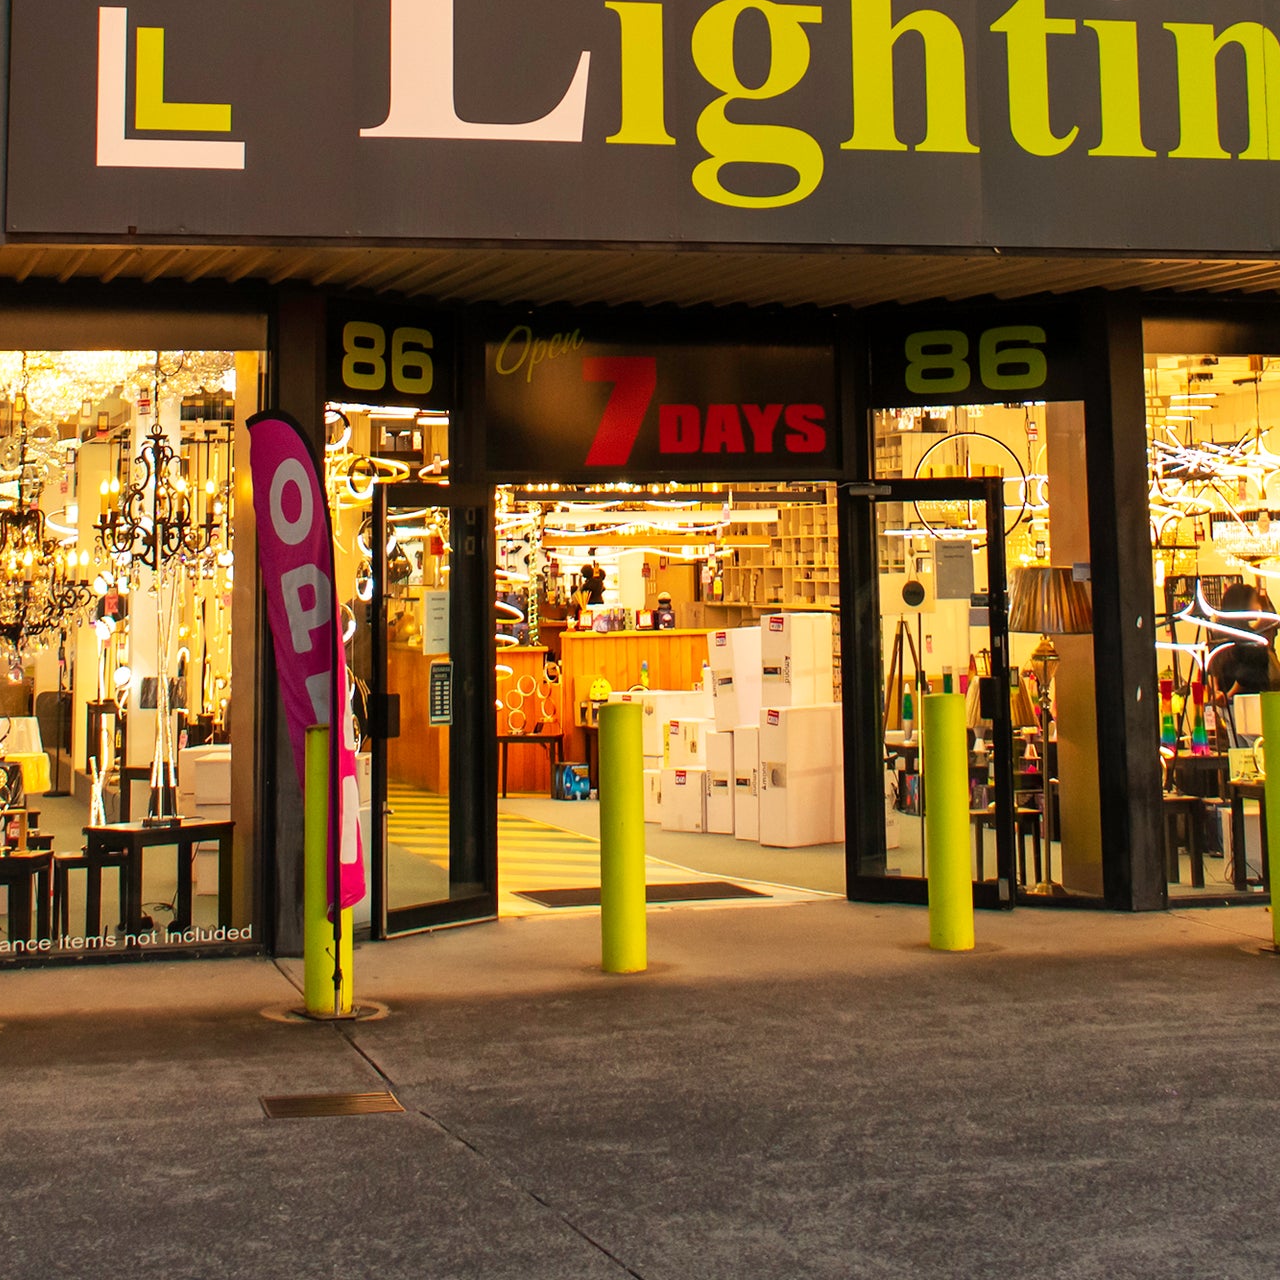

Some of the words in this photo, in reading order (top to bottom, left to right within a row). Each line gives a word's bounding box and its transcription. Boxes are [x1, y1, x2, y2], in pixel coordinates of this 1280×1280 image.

[342, 320, 434, 395] 86
[495, 325, 584, 383] Open
[904, 325, 1048, 394] 86
[582, 356, 657, 467] 7
[659, 404, 826, 454] DAYS
[59, 933, 117, 951] items
[124, 930, 158, 947] not
[164, 923, 253, 945] included
